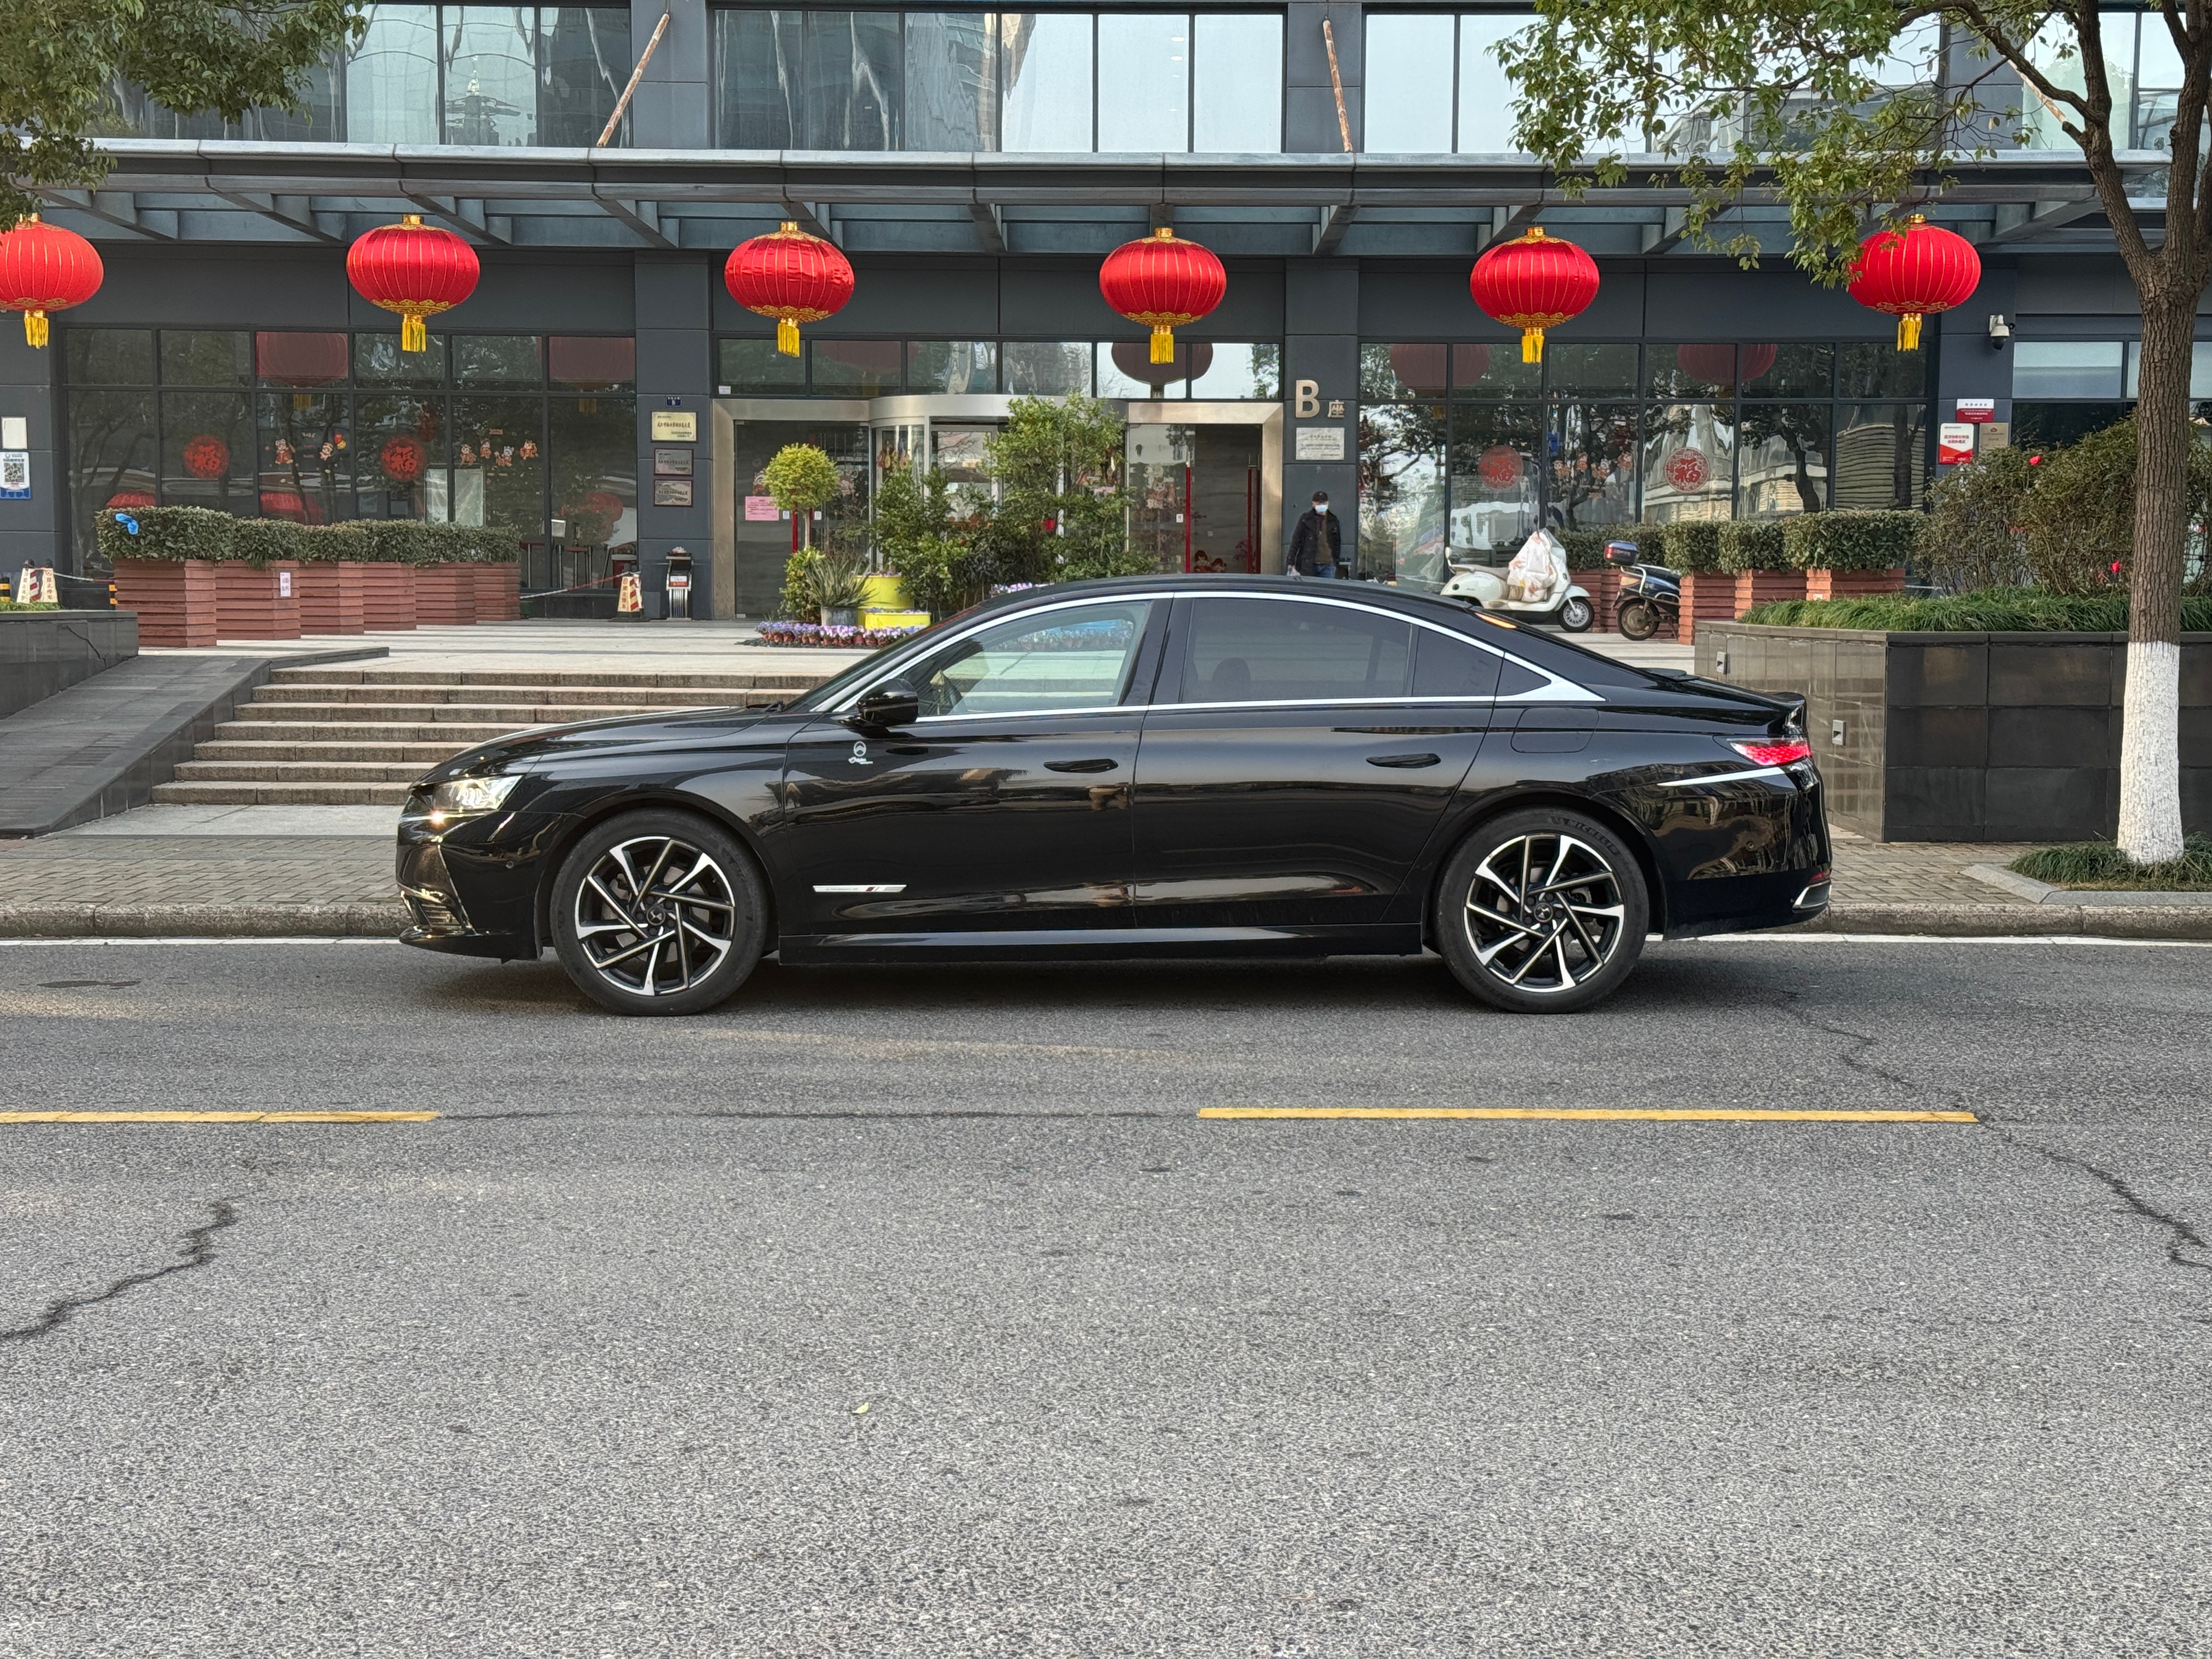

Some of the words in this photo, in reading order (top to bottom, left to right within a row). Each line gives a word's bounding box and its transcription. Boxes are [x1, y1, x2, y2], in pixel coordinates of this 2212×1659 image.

[1296, 380, 1345, 418] B座
[1674, 458, 1701, 483] 福
[1567, 820, 1620, 855] MICHELIN
